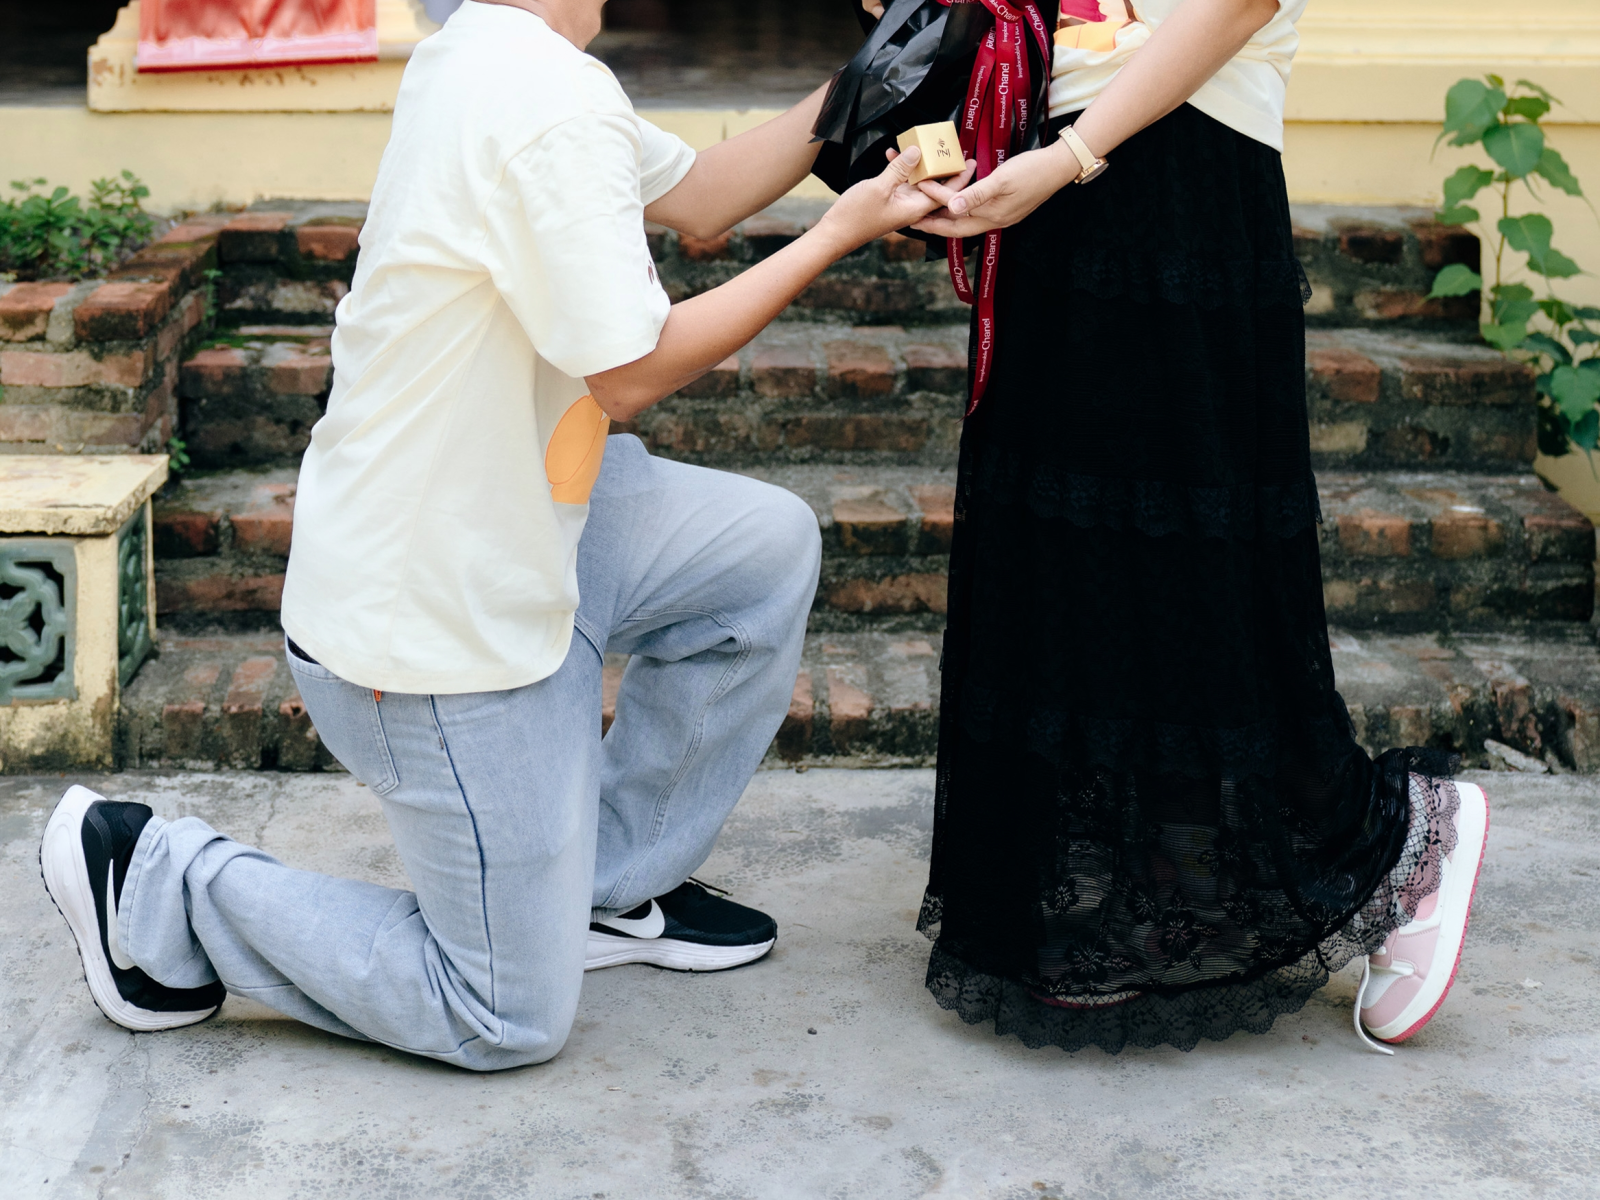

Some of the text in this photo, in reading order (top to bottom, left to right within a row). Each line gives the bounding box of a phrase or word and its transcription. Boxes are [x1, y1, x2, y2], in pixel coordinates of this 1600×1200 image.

[1025, 4, 1044, 31] Chanel
[998, 62, 1010, 95] Chanel
[965, 97, 980, 130] Chanel
[1018, 98, 1028, 131] Chanel
[986, 234, 998, 266] Chanel
[953, 266, 968, 293] Chanel
[981, 318, 991, 350] Chanel
